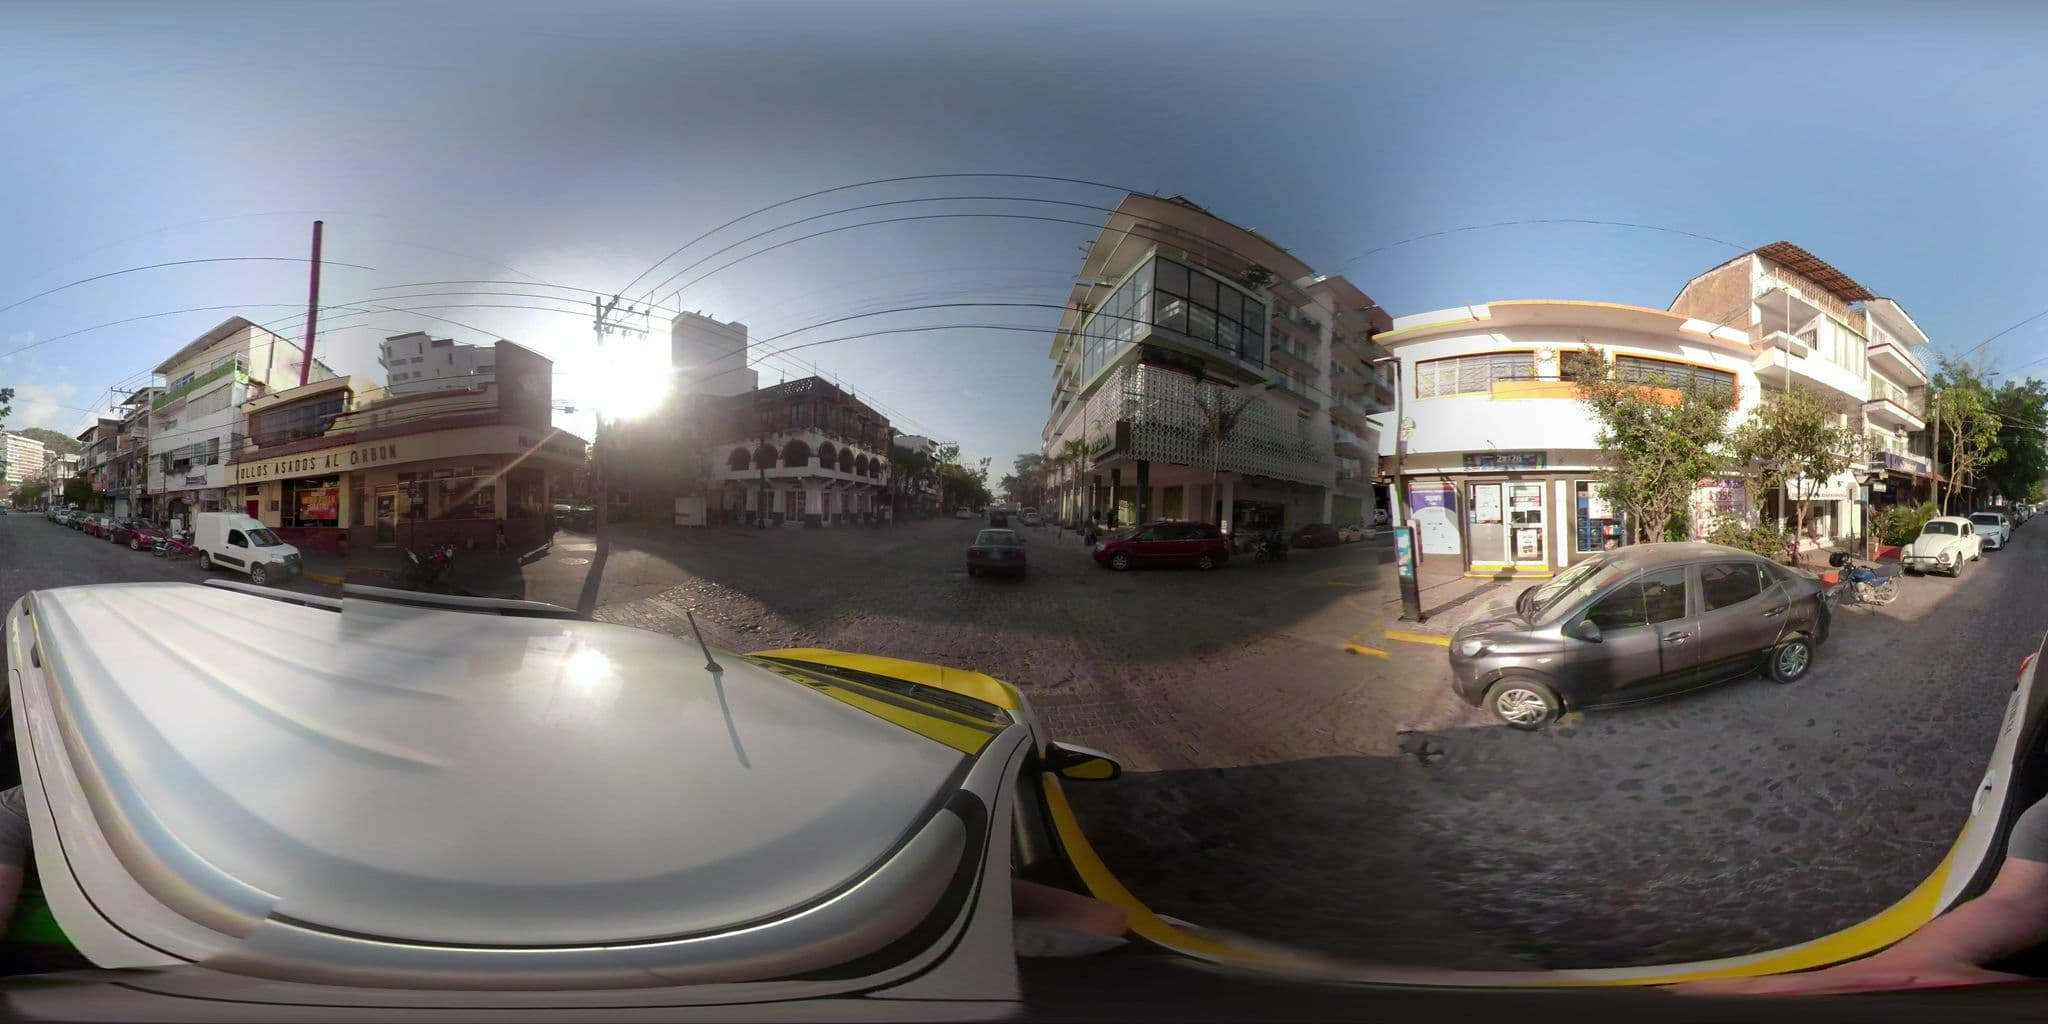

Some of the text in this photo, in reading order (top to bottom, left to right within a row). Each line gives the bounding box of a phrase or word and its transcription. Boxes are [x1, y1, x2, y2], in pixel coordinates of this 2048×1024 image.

[236, 464, 268, 480] OLLOS
[275, 457, 316, 475] ASADOS
[325, 455, 340, 469] AL
